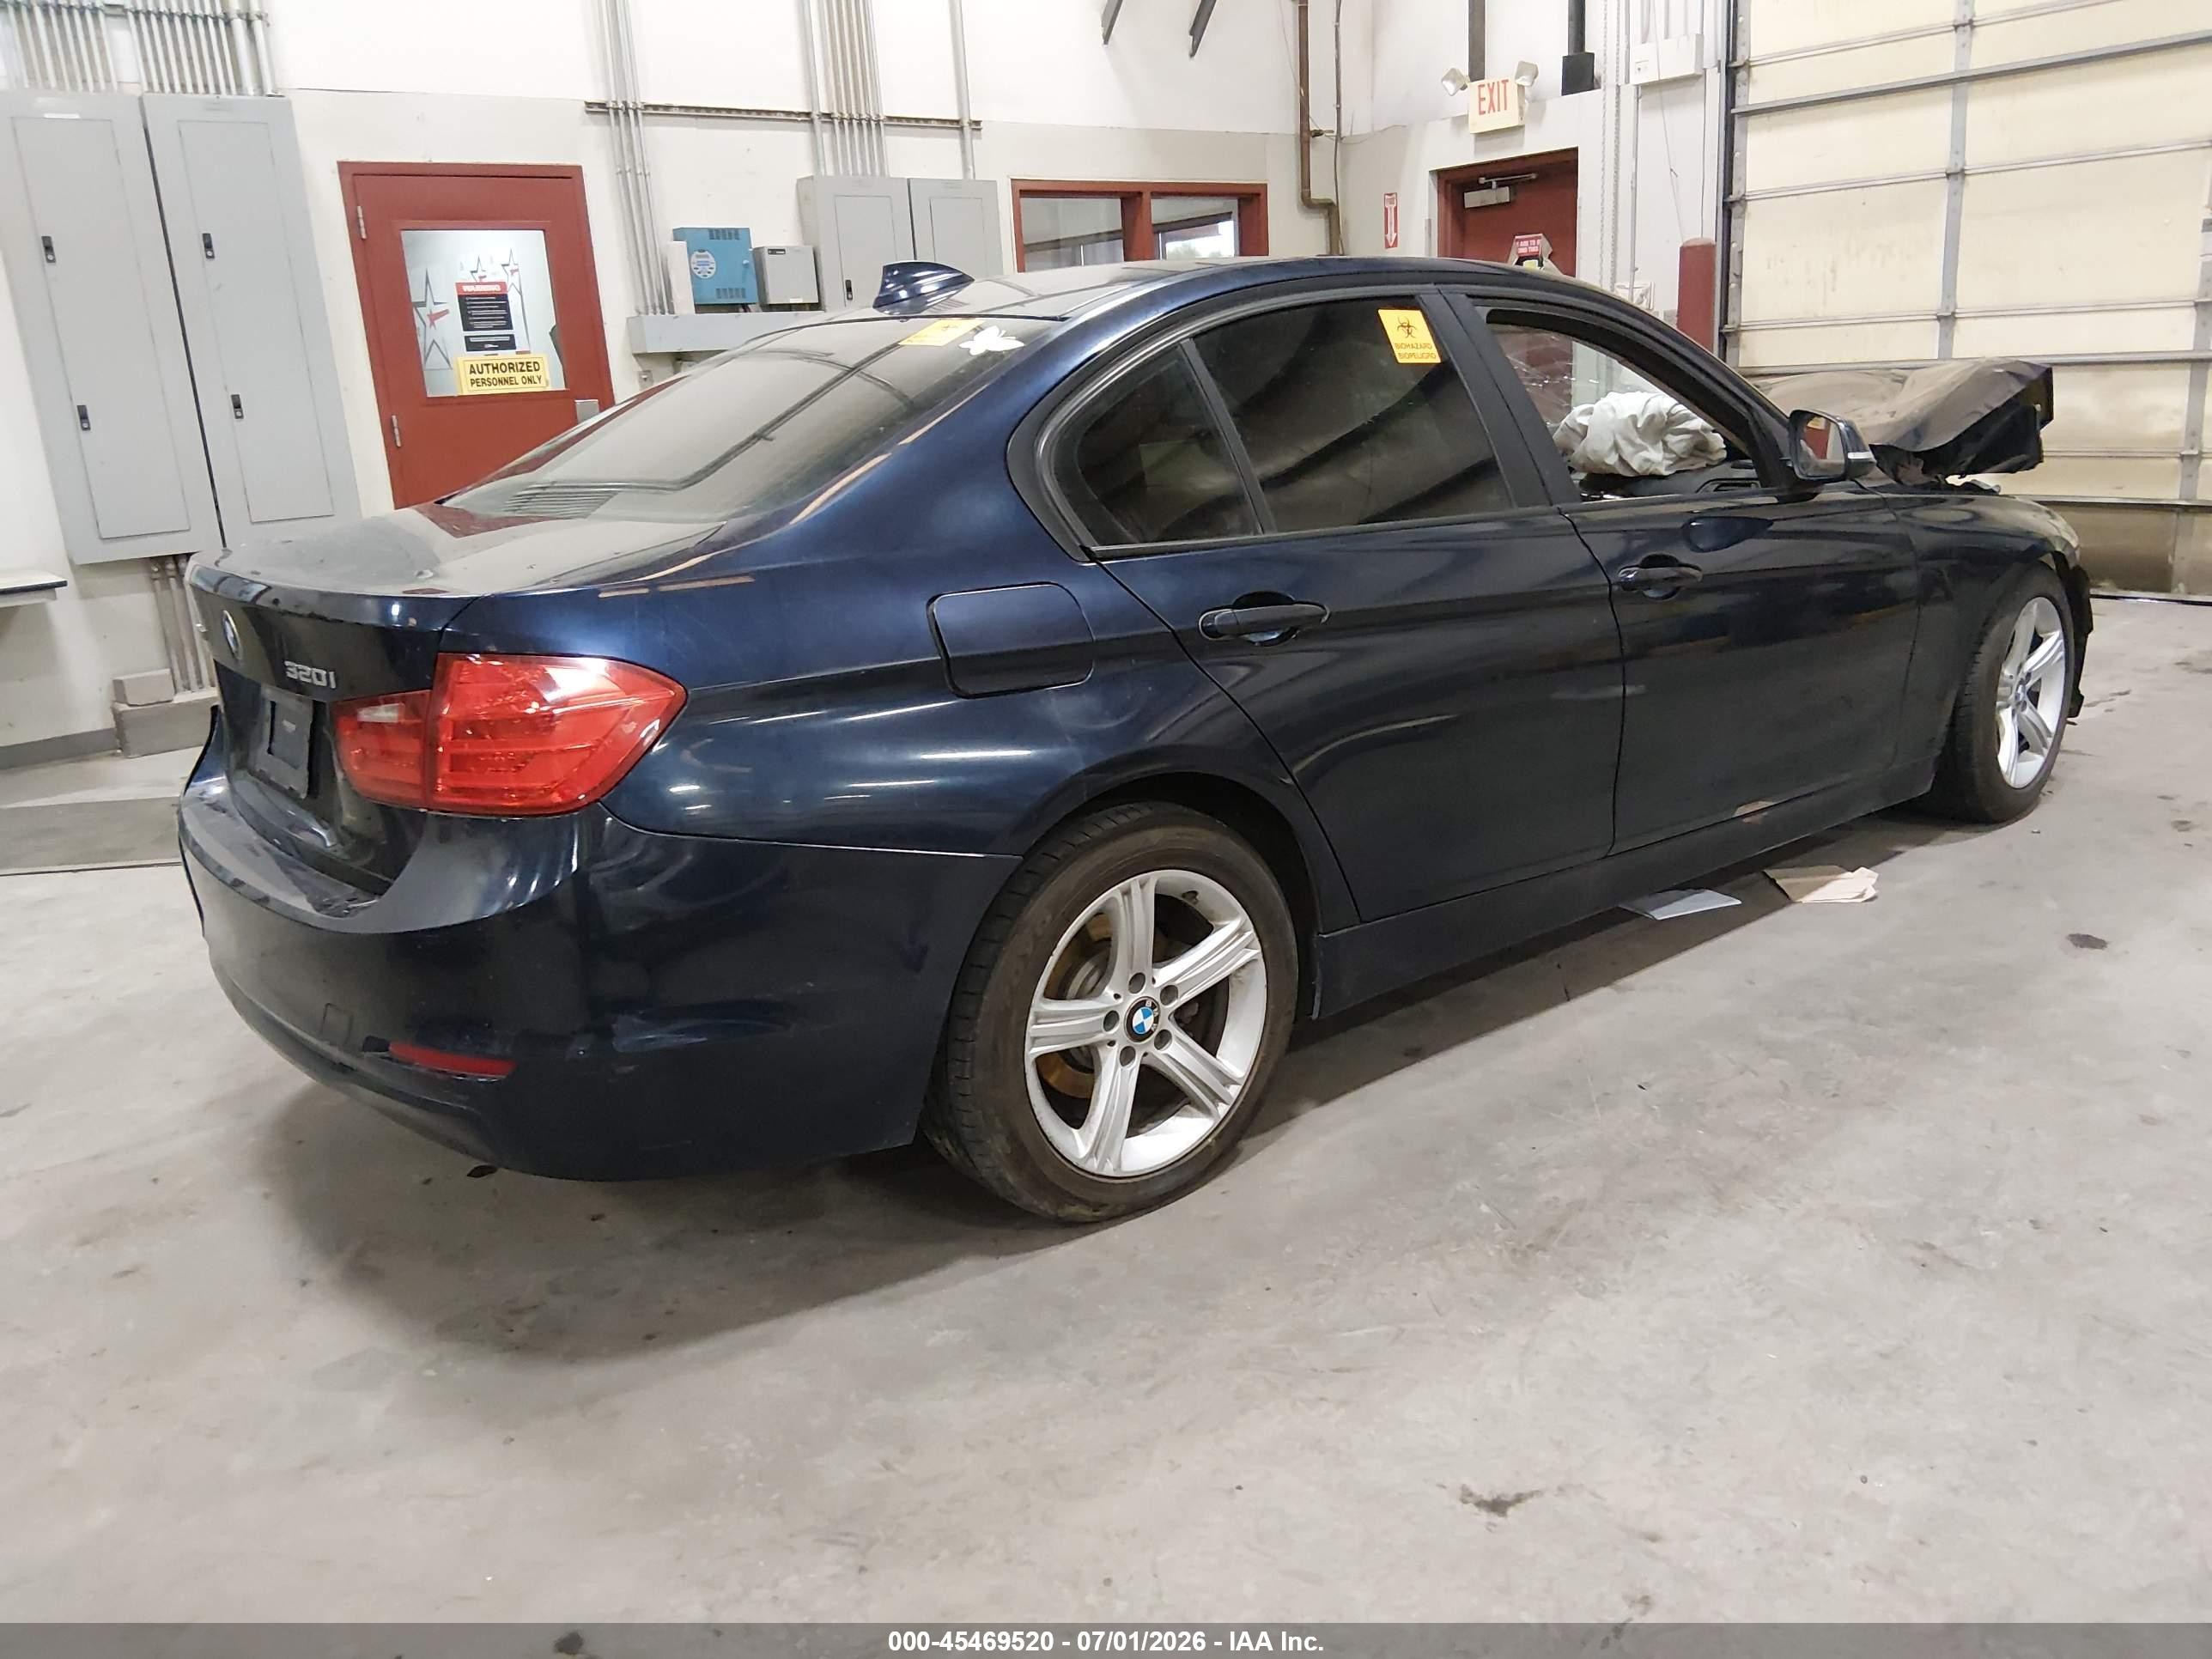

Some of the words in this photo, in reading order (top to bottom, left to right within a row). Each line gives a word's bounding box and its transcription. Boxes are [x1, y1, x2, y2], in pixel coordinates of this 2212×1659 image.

[1478, 79, 1509, 115] EXIT
[469, 362, 540, 374] AUTHORIZED
[471, 376, 519, 386] PERSONNEL
[521, 375, 542, 385] ONLY
